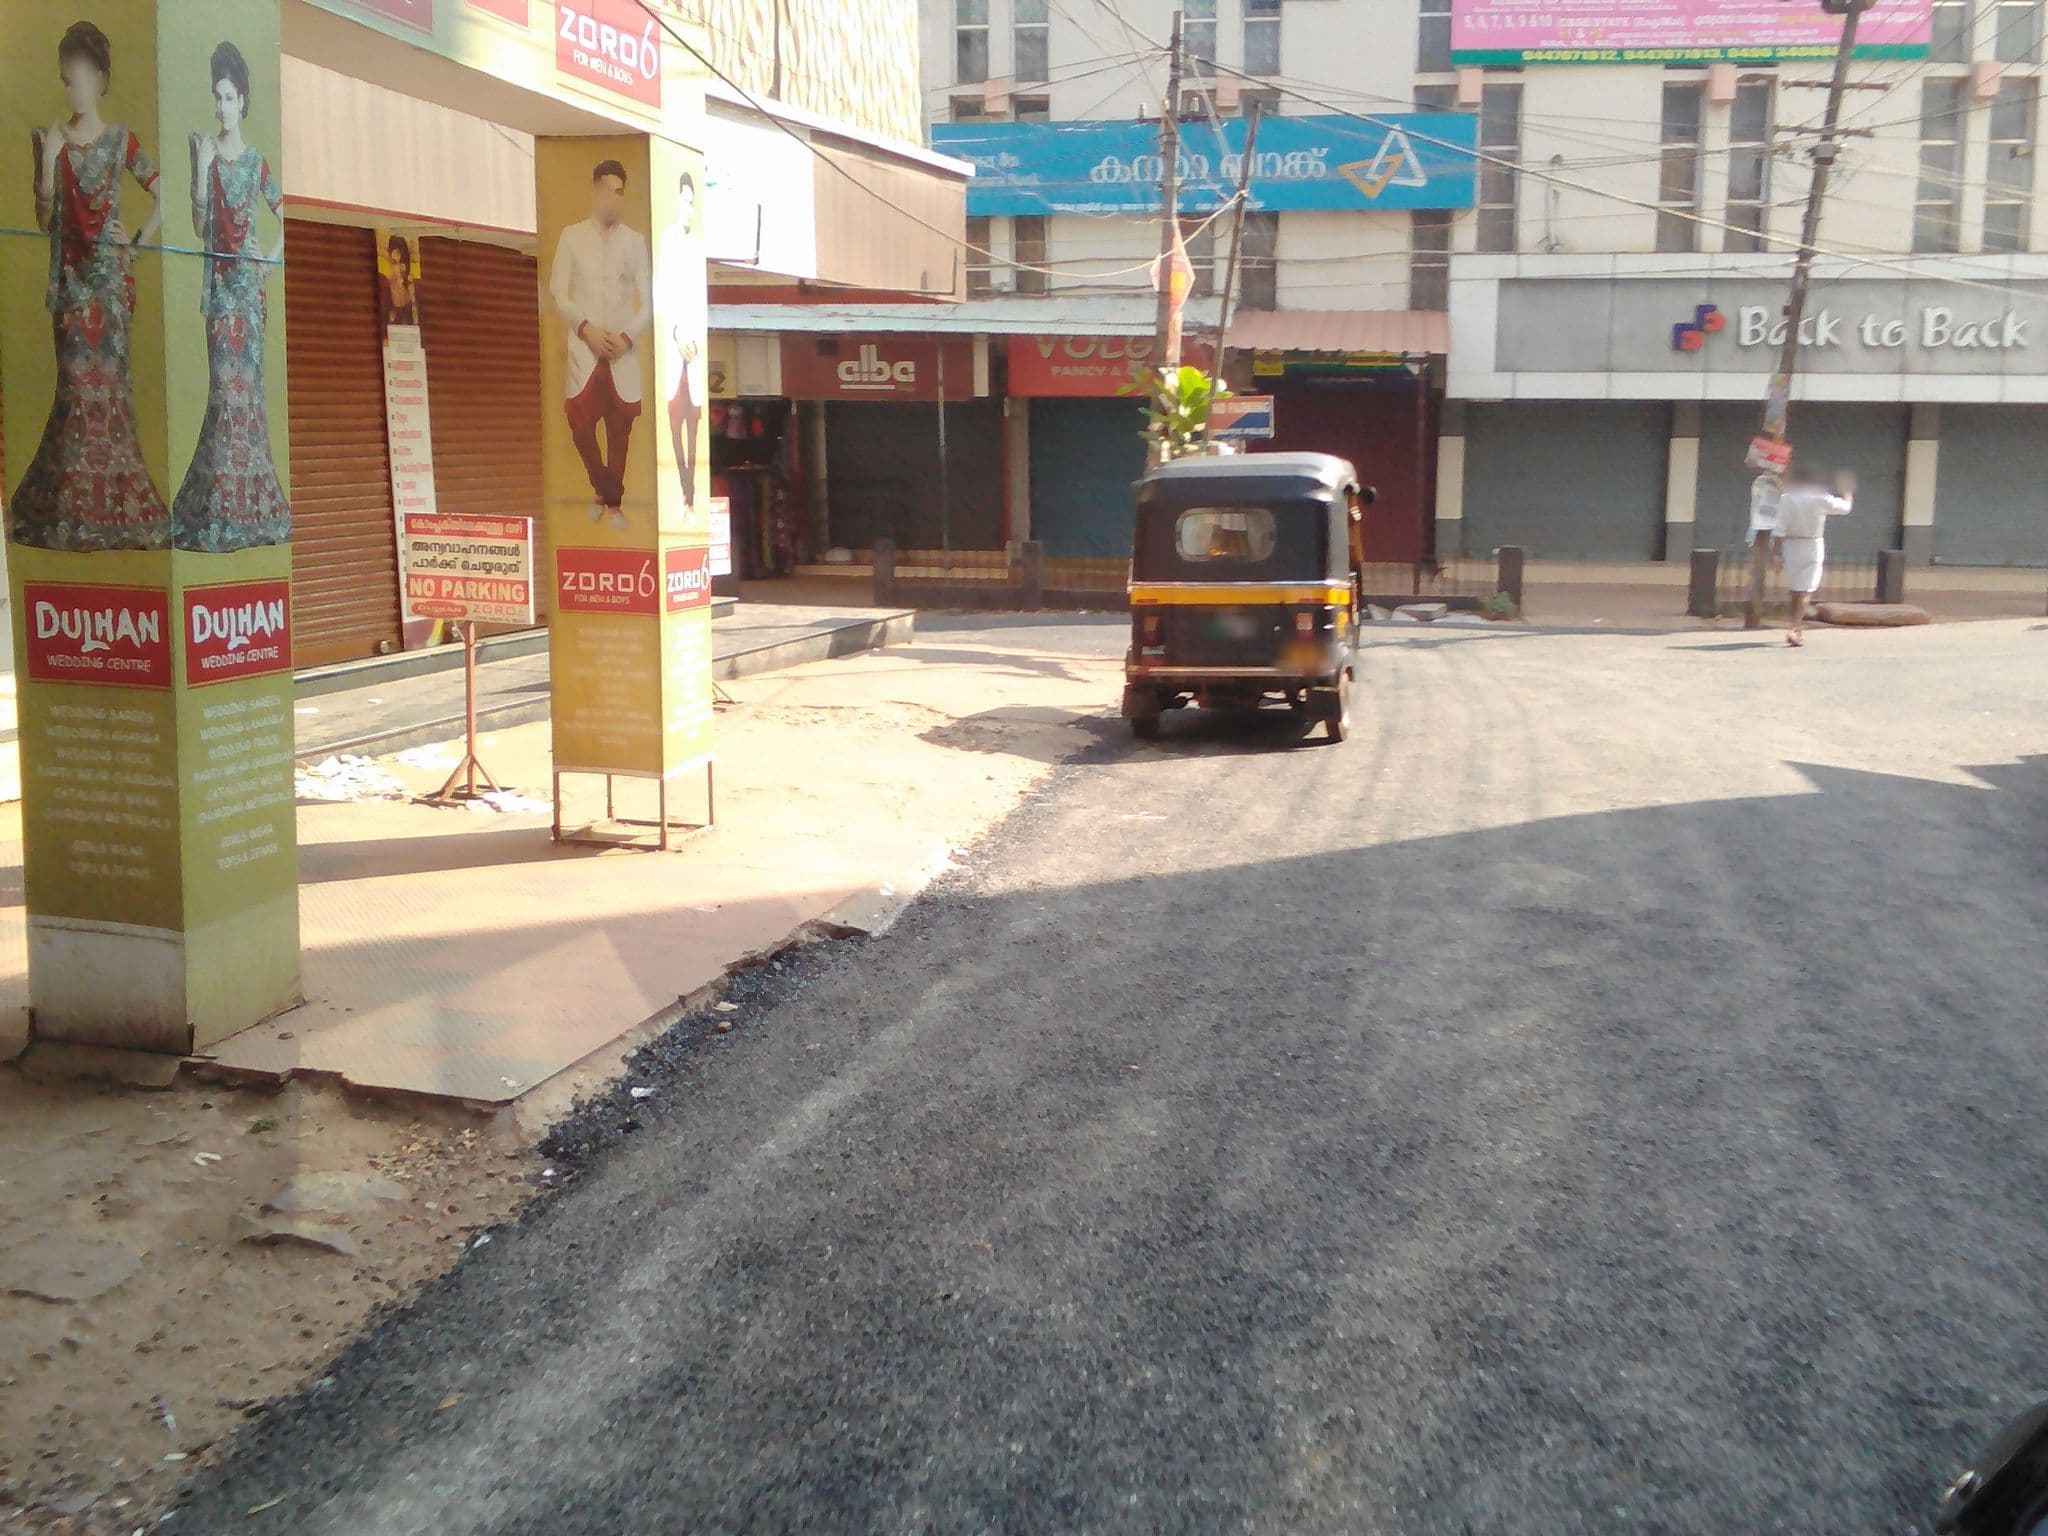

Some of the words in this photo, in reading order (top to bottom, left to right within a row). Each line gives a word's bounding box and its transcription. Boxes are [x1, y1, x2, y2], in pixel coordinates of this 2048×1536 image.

[1738, 304, 1841, 347] Back
[1860, 313, 1905, 347] to
[1921, 305, 2029, 348] Back
[409, 577, 436, 597] NO
[441, 579, 526, 602] PARKING
[35, 600, 160, 653] DULHAN
[192, 599, 285, 651] DULHAN
[47, 654, 104, 670] WEDDING
[106, 656, 151, 673] CENTRE
[201, 653, 245, 670] WEDDING
[246, 645, 279, 662] CENTRE
